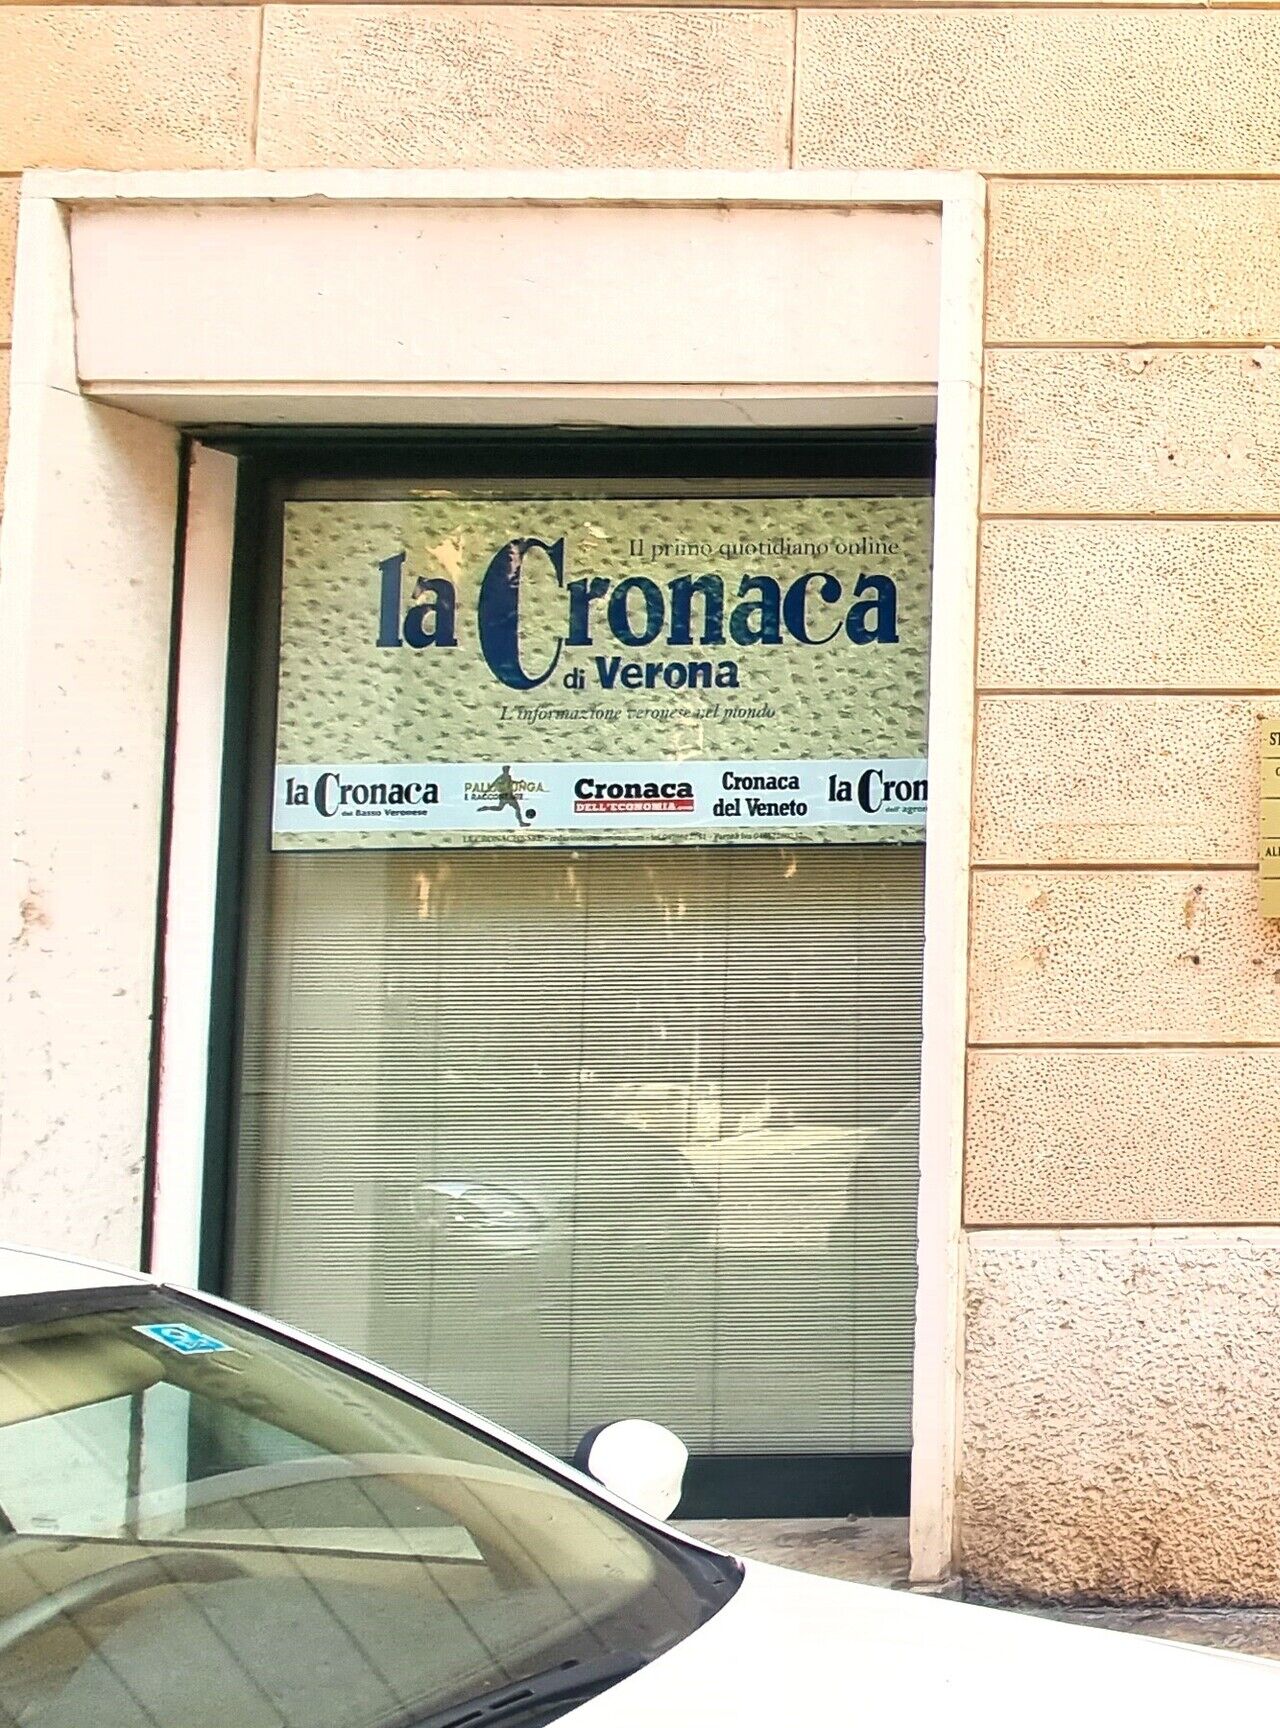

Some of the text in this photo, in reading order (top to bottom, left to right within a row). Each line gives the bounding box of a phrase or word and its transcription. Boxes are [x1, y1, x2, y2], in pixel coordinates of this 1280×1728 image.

[629, 537, 900, 562] Il primo quotidiano online
[376, 537, 900, 690] la Cronaca
[563, 655, 740, 690] di Verona
[500, 704, 623, 725] L'informazione
[722, 702, 777, 721] mondo
[574, 778, 694, 799] Cronaca
[722, 771, 800, 790] Cronaca
[828, 774, 852, 801] la
[285, 772, 439, 818] la Cronaca
[356, 809, 382, 817] Basso
[385, 808, 428, 816] Veronese
[576, 802, 677, 812] DELL'ECONOMIA
[712, 798, 808, 817] del Veneto
